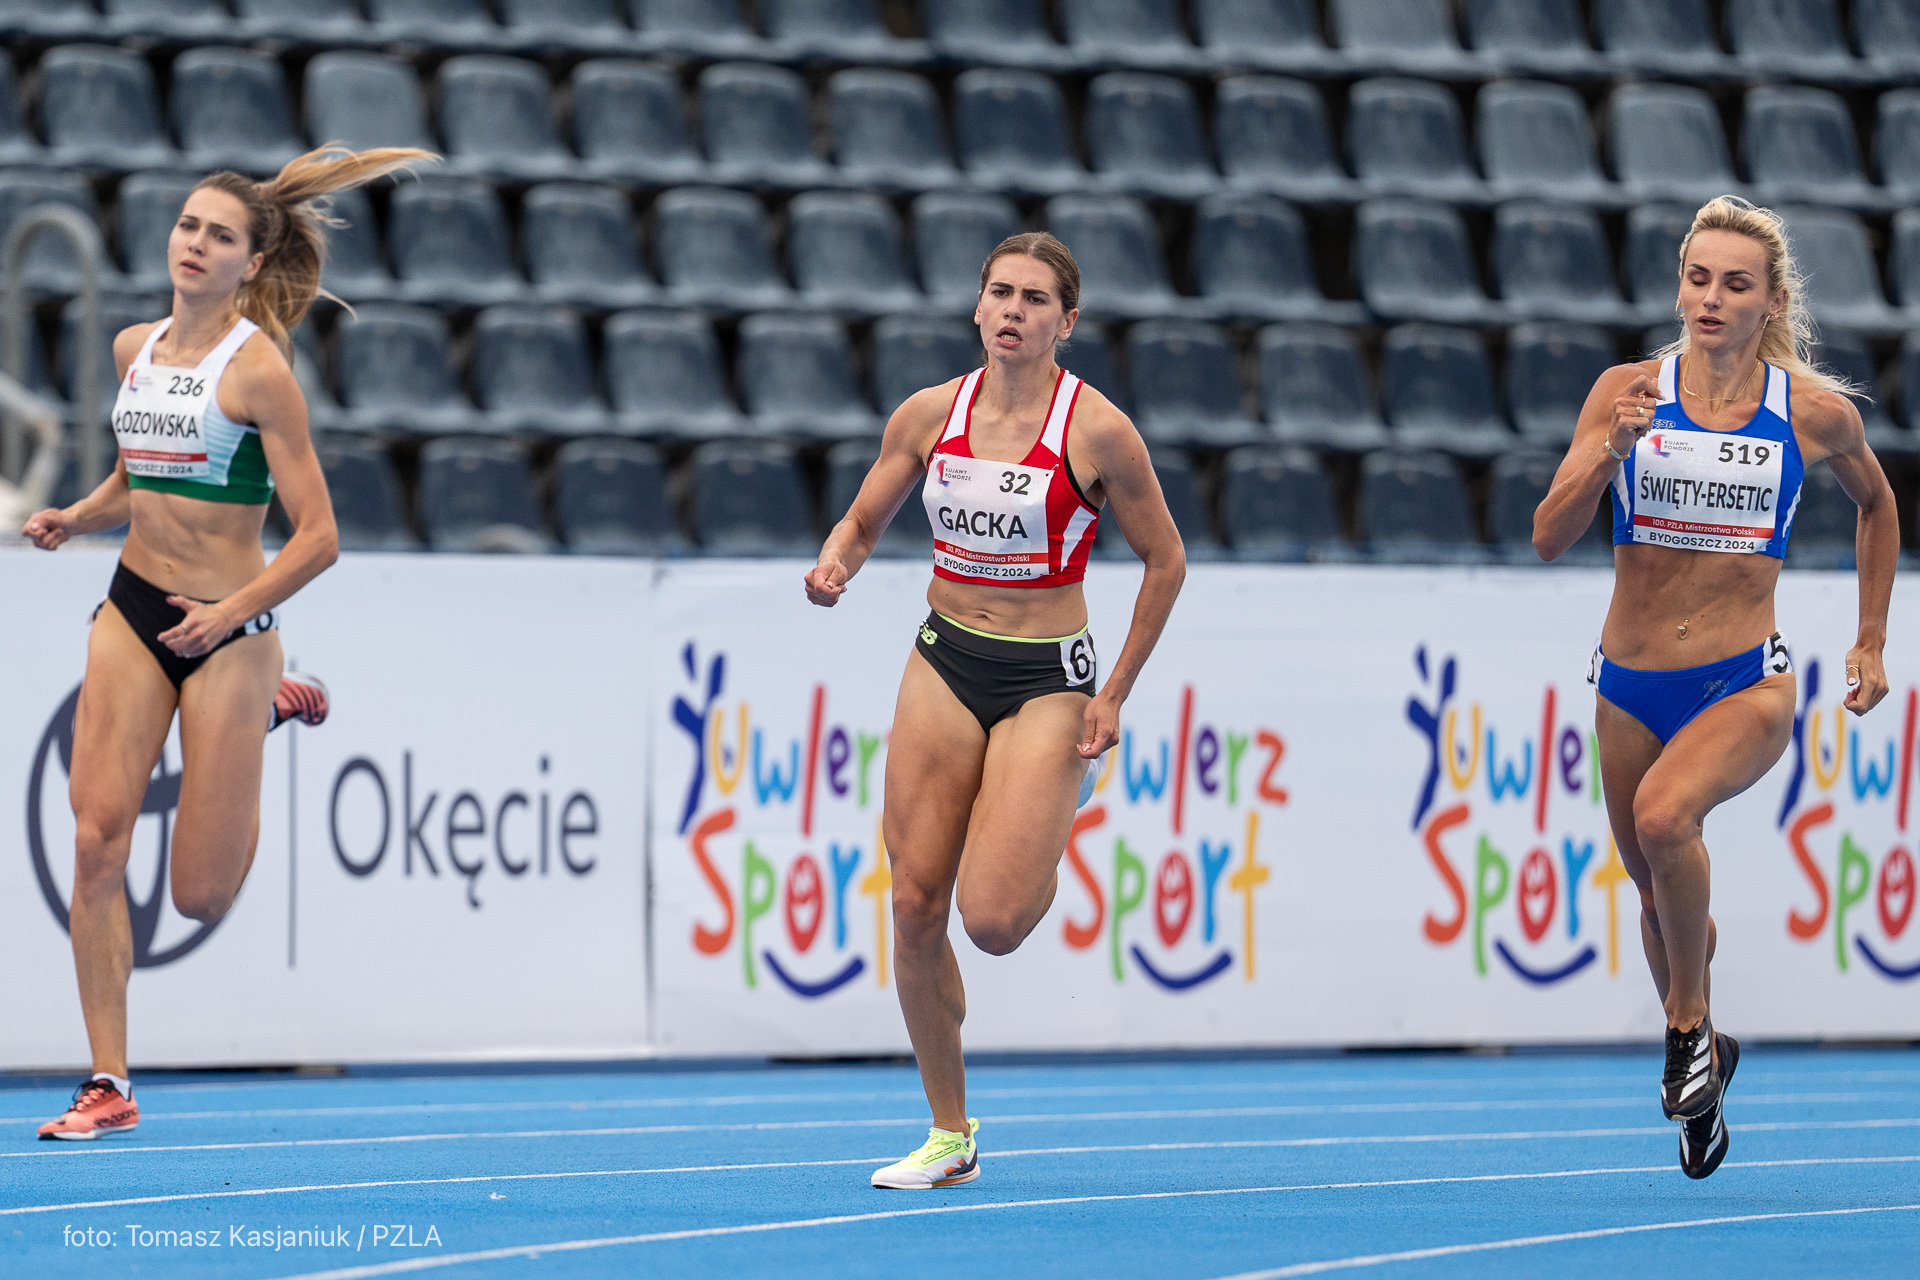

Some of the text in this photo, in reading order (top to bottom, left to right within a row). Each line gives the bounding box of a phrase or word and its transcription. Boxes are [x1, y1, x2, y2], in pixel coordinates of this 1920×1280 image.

[167, 375, 206, 397] 236
[116, 411, 199, 439] ŁOZOWSKA
[1664, 445, 1694, 453] POMORZE
[1718, 441, 1770, 466] 519
[167, 465, 193, 474] 2024
[945, 467, 967, 475] KUJAWY
[945, 472, 972, 482] POMORZE
[999, 470, 1031, 496] 32
[1640, 470, 1773, 512] ŚWIĘTY-ERSETIC
[938, 506, 1028, 539] GACKA
[1652, 518, 1755, 536] 100. PZLA Mistrzostwa Polski
[1649, 532, 1755, 550] BYDGOSZCZ 2024
[943, 557, 1031, 577] BYDGOSZCZ 2024
[966, 552, 1006, 563] Mistrzostwa
[1007, 554, 1030, 562] Polski
[1070, 639, 1090, 680] 6
[1769, 631, 1788, 673] 5
[329, 750, 600, 910] Okęcie
[690, 808, 893, 990] Sport
[1063, 805, 1269, 982] Sport
[1422, 802, 1632, 978] Sport
[1787, 801, 1920, 975] Spo
